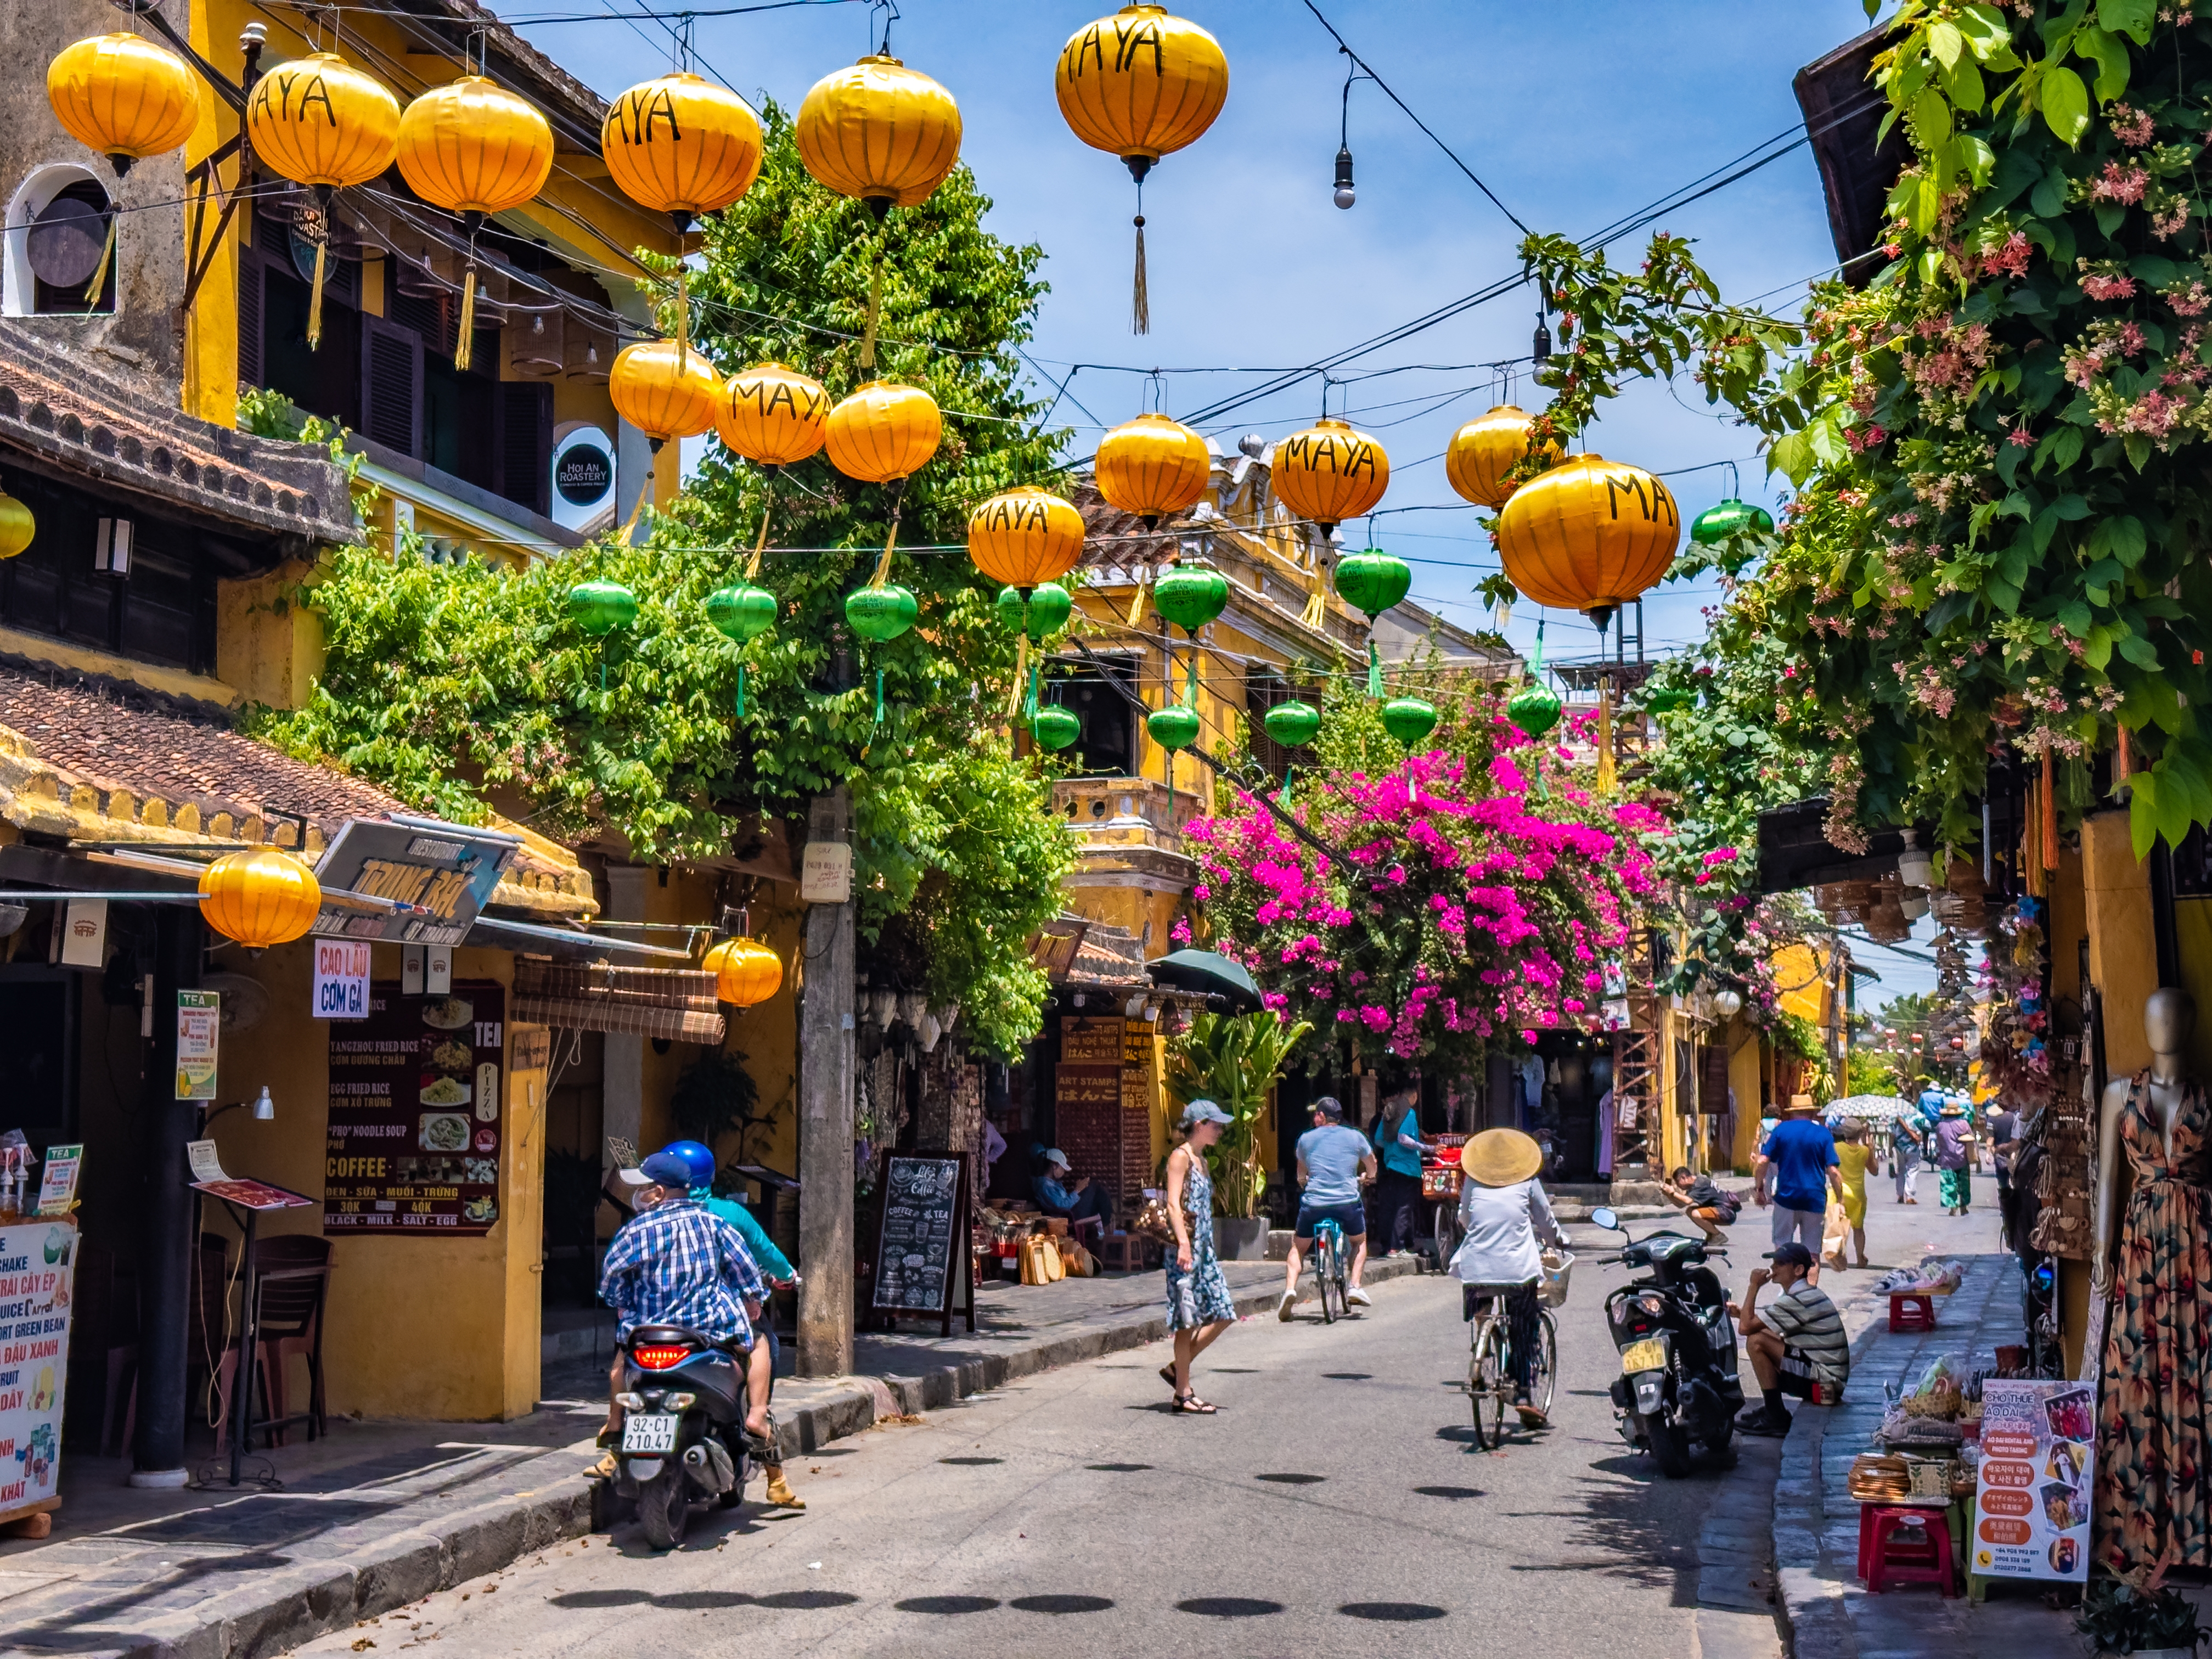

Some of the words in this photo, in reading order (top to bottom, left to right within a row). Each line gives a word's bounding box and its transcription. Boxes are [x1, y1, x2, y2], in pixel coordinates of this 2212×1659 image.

[252, 72, 336, 128] AYA
[605, 87, 682, 148] AYA
[1285, 435, 1375, 484] MAYA
[567, 463, 583, 473] HOI
[586, 463, 599, 472] AN
[560, 471, 606, 482] ROASTERY
[971, 500, 1048, 535] MAYA
[354, 859, 434, 904] TRUNG
[320, 947, 342, 976] CAO
[183, 994, 205, 1006] TEA
[321, 978, 346, 1012] CƠM
[348, 979, 362, 1013] GÀ
[330, 1041, 374, 1053] YANGZHOU
[375, 1041, 399, 1053] FRIED
[401, 1041, 419, 1053] RICE
[1059, 1077, 1077, 1086] ART
[1080, 1077, 1118, 1086] STAMPS
[330, 1083, 346, 1094] EGG
[347, 1083, 370, 1094] FRIED
[372, 1083, 390, 1094] RICE
[1057, 1089, 1118, 1101] はんこ
[353, 1126, 385, 1137] NOODLE
[385, 1126, 407, 1137] SOUP
[1439, 1136, 1466, 1145] COFFEE
[52, 1149, 70, 1160] TEA
[327, 1157, 386, 1177] COFFEE
[888, 1207, 914, 1216] COFFEE
[933, 1210, 948, 1219] TEA
[324, 1215, 357, 1225] BLACK
[367, 1215, 393, 1225] MILK
[403, 1215, 427, 1225] SALT
[437, 1215, 458, 1225] EGG
[15, 1320, 42, 1338] GREEN
[44, 1317, 65, 1334] BEAN
[30, 1339, 59, 1359] XANH
[1986, 1394, 2007, 1403] CHO
[626, 1435, 672, 1449] 210.47
